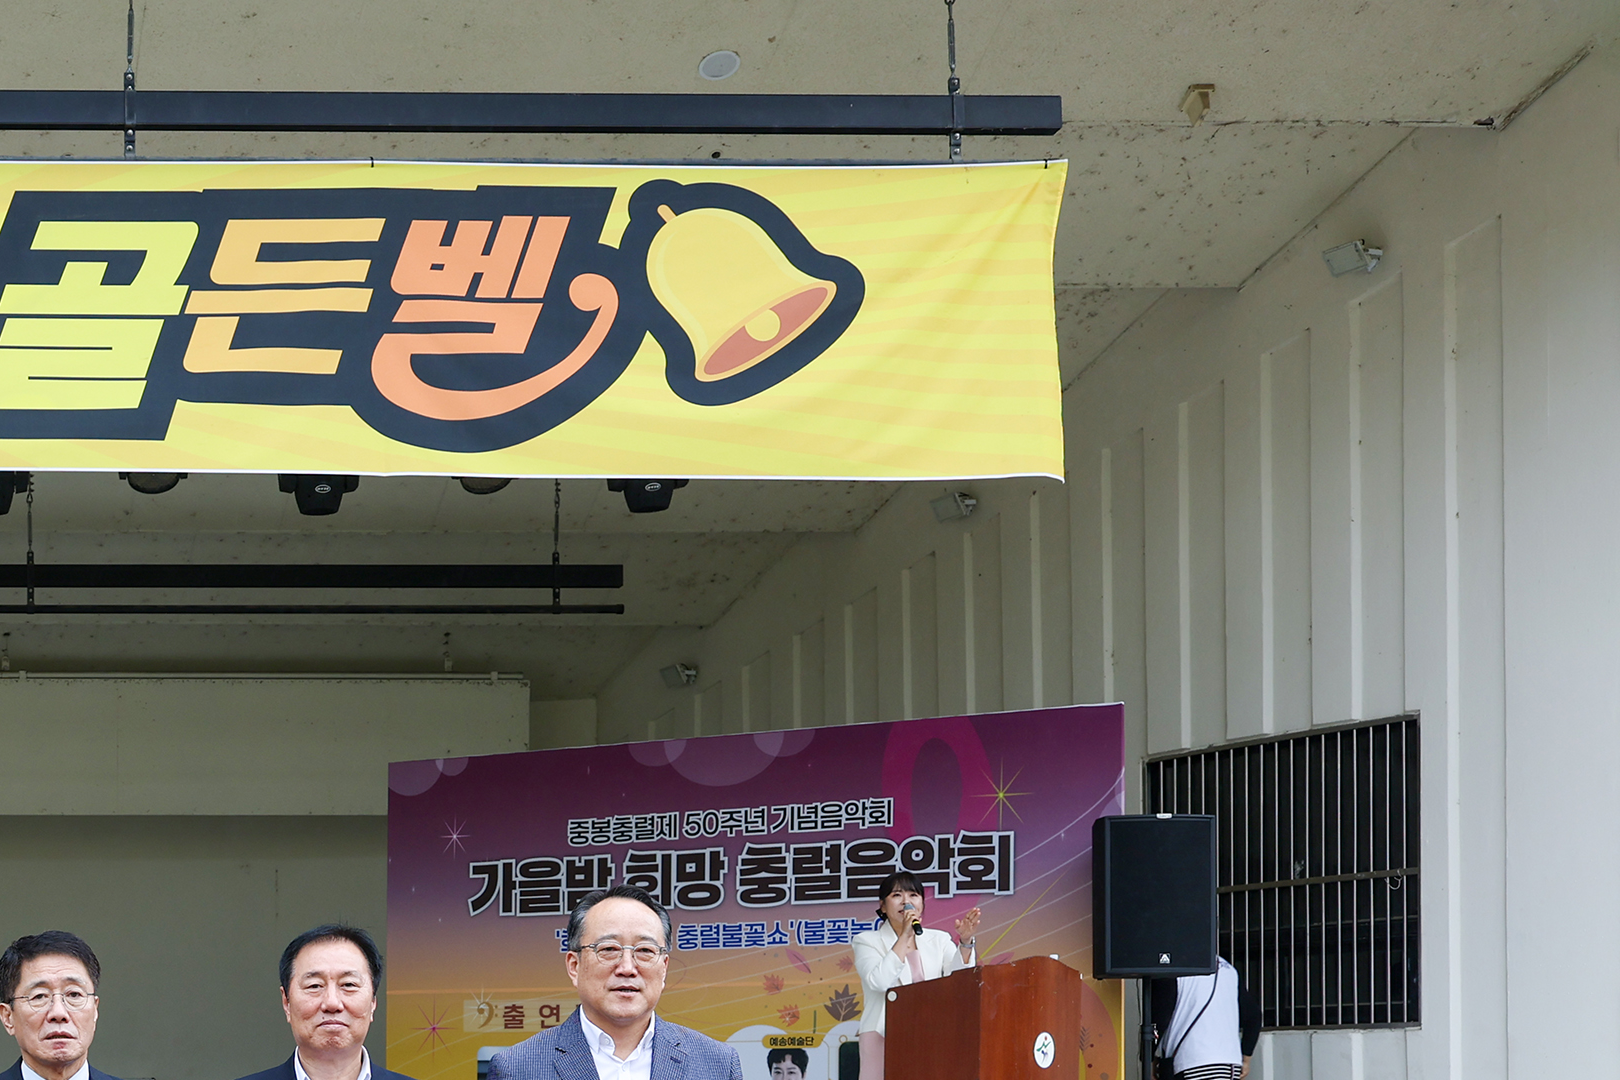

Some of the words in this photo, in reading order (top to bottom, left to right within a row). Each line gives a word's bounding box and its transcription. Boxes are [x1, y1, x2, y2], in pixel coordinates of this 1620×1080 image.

[568, 820, 679, 846] 중봉충렬제
[683, 808, 766, 838] 50주년
[771, 799, 893, 832] 기념음악회
[623, 849, 727, 910] 희망
[737, 831, 1013, 907] 충렬음악회
